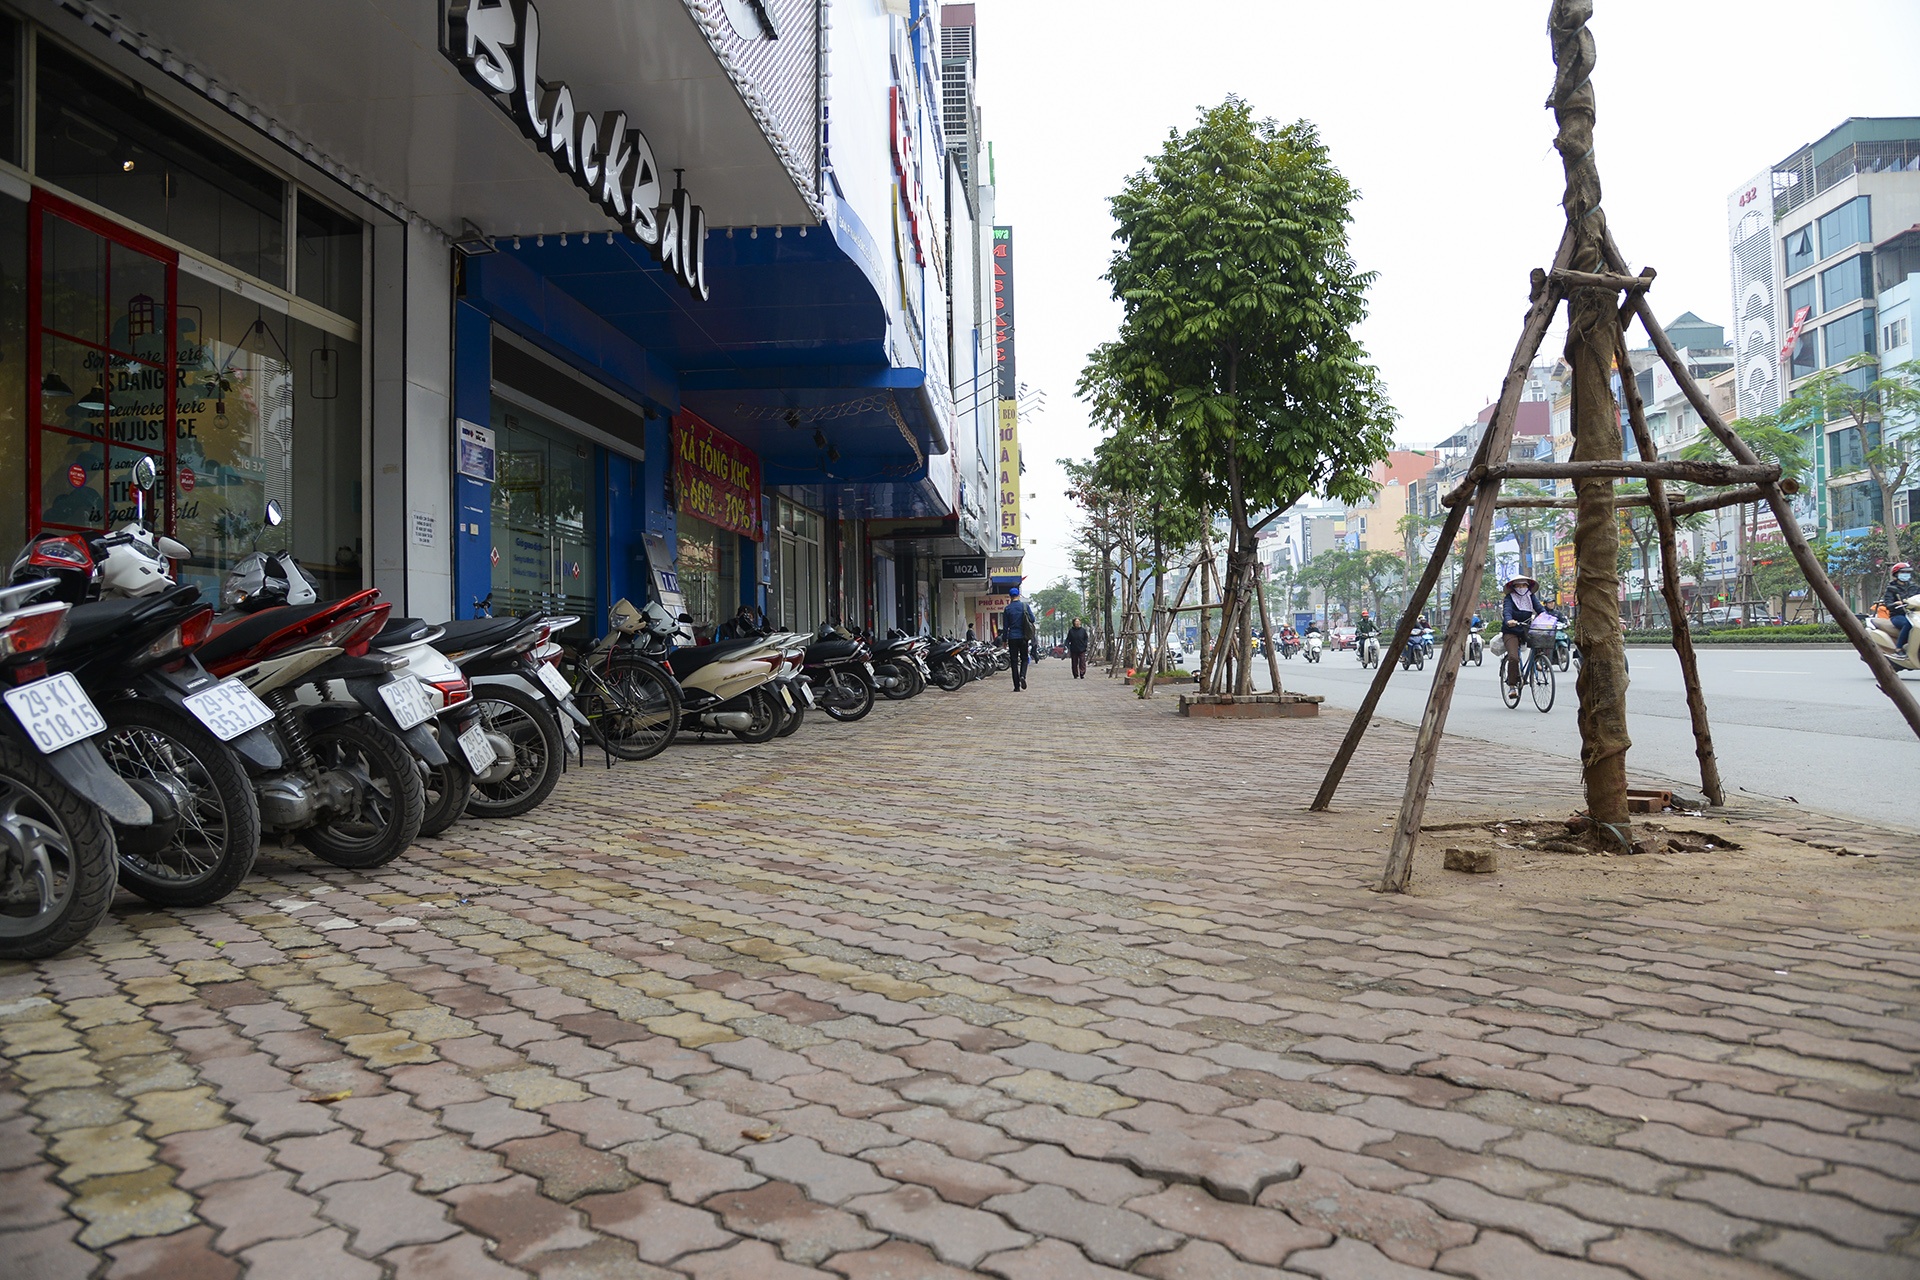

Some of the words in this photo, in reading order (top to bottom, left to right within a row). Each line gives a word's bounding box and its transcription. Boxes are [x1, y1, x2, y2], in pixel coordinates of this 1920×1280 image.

[1739, 187, 1757, 207] 432
[118, 368, 187, 392] DANGR
[109, 418, 198, 442] INJUSTCE
[679, 424, 697, 465] XẢ
[699, 430, 729, 481] TỔNG
[954, 565, 978, 574] MOZA
[186, 677, 208, 689] HONDA
[386, 679, 421, 706] 29-P1
[20, 680, 76, 718] 29-K1
[395, 696, 433, 727] 067.45
[33, 703, 98, 746] 618.15
[209, 700, 268, 736] 353.71
